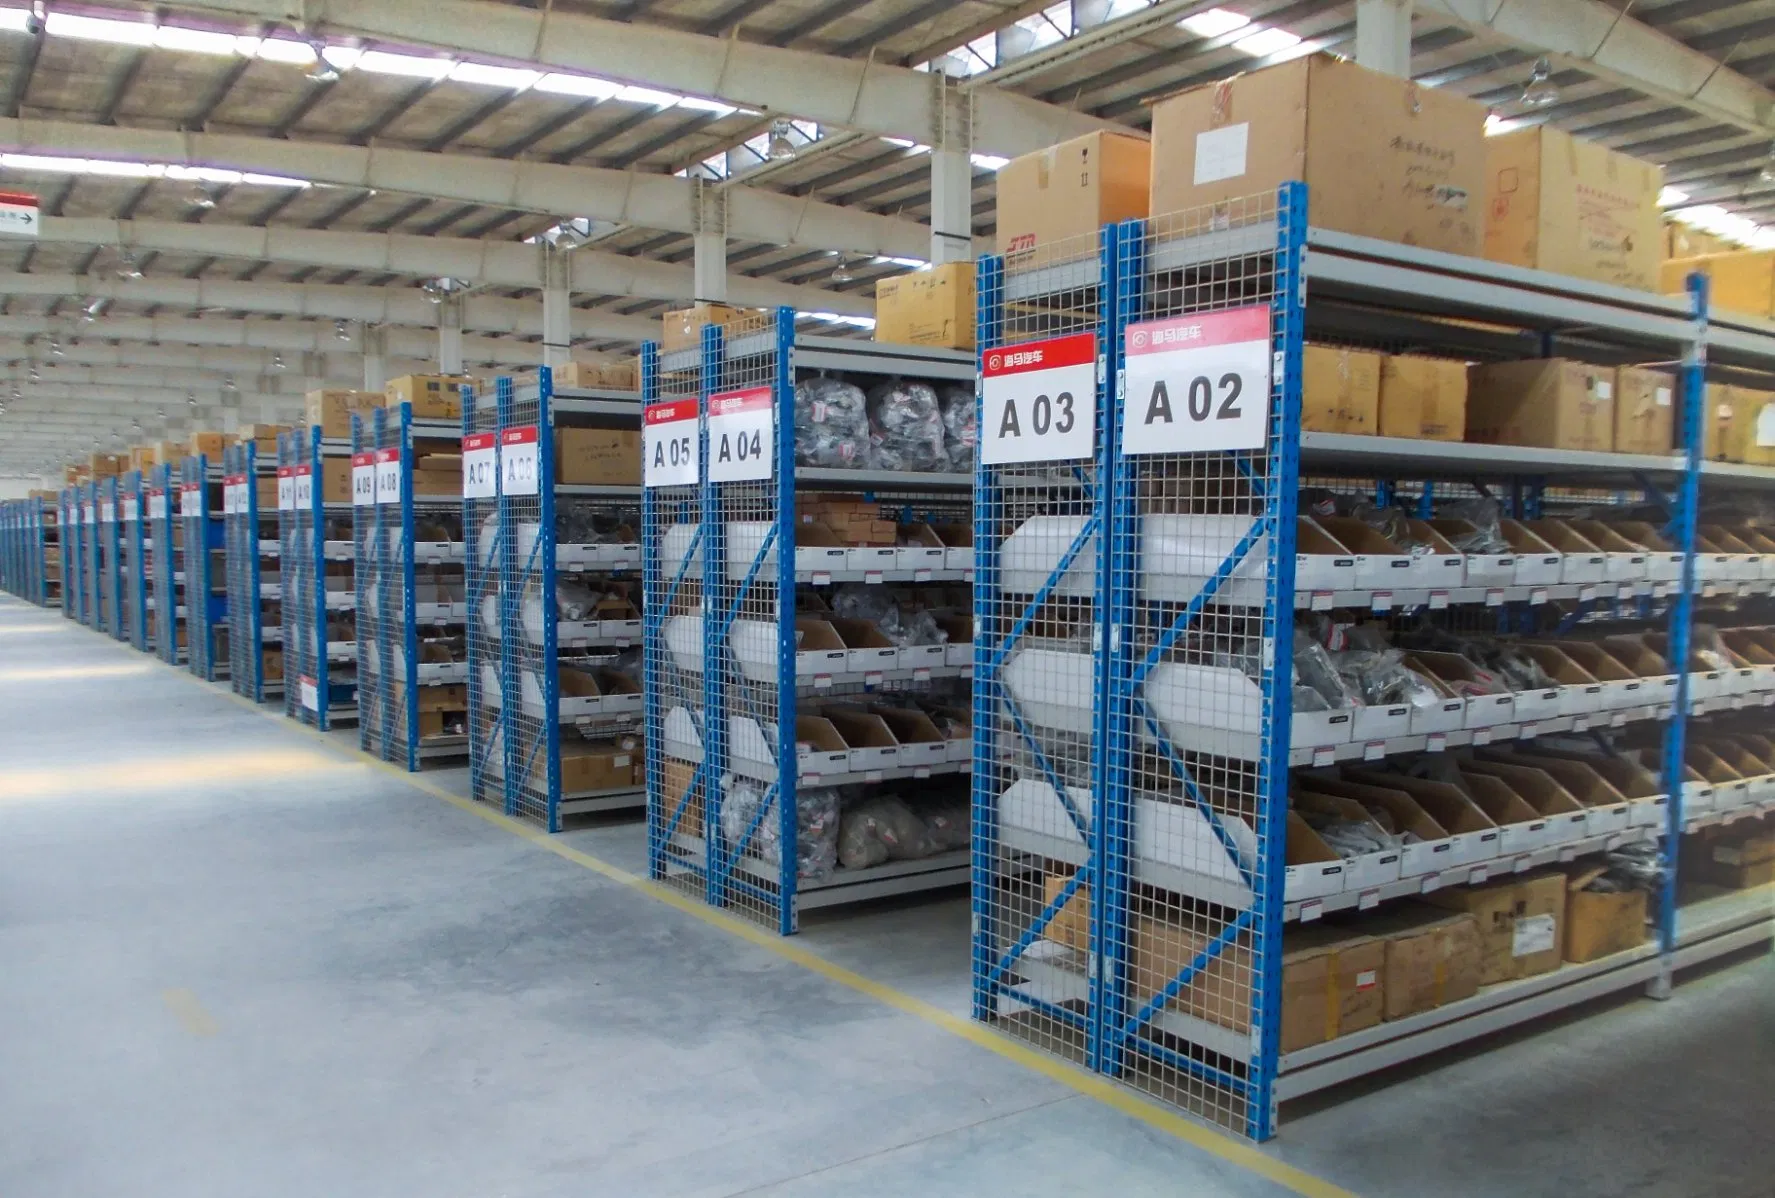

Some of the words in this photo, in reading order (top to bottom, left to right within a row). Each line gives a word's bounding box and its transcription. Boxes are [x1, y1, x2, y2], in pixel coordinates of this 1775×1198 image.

[1151, 324, 1202, 346] 海马汽车
[1003, 349, 1043, 368] 海马汽车
[1144, 380, 1173, 425] A
[1188, 372, 1243, 422] 02
[998, 398, 1021, 439] A
[1032, 391, 1075, 435] 03
[654, 440, 665, 468] A
[670, 437, 690, 467] 05
[718, 433, 731, 463] A
[737, 428, 762, 462] 04
[469, 463, 476, 485] A
[478, 461, 490, 483] 07
[508, 457, 516, 481] A
